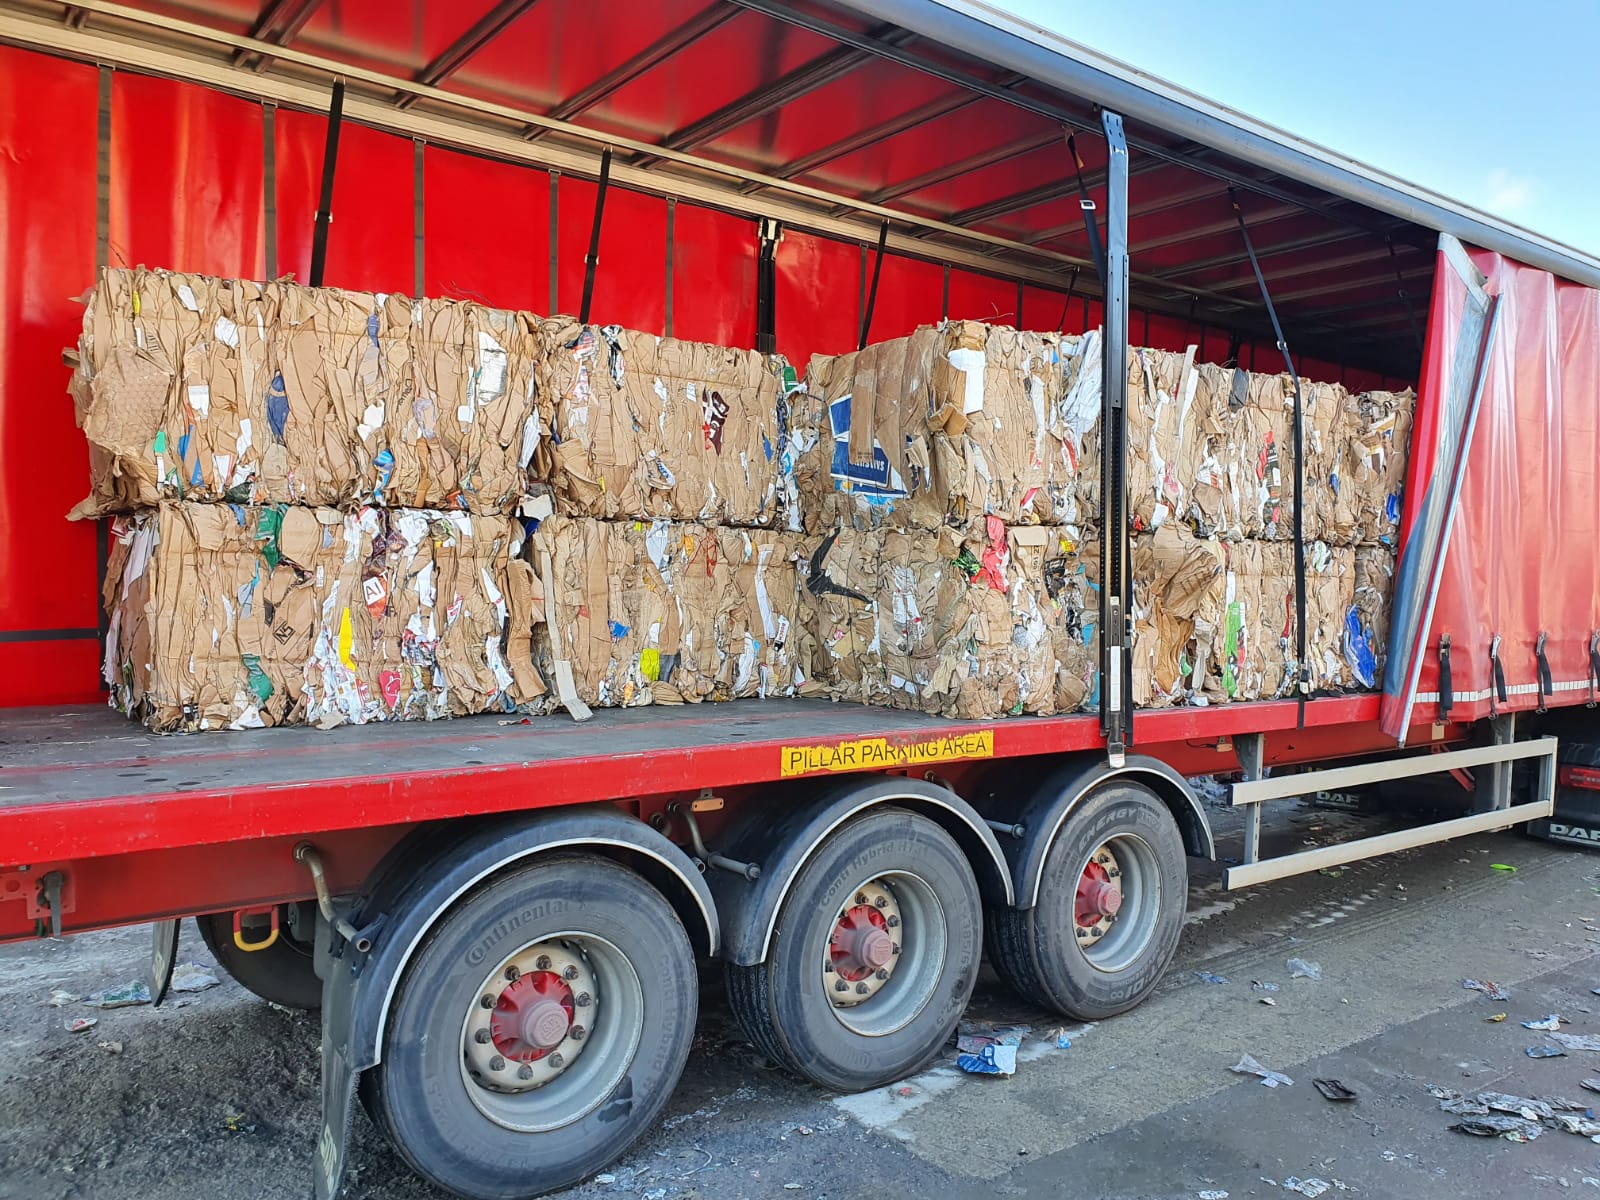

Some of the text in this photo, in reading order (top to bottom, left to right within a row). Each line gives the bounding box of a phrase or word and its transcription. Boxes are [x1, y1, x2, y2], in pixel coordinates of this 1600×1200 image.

[790, 735, 986, 770] PILLAR PARKING AREA
[1316, 791, 1360, 804] DAF
[1079, 807, 1138, 851] ENERGY
[820, 866, 852, 906] Conti
[852, 840, 895, 871] Hybrid
[464, 899, 570, 967] Continental
